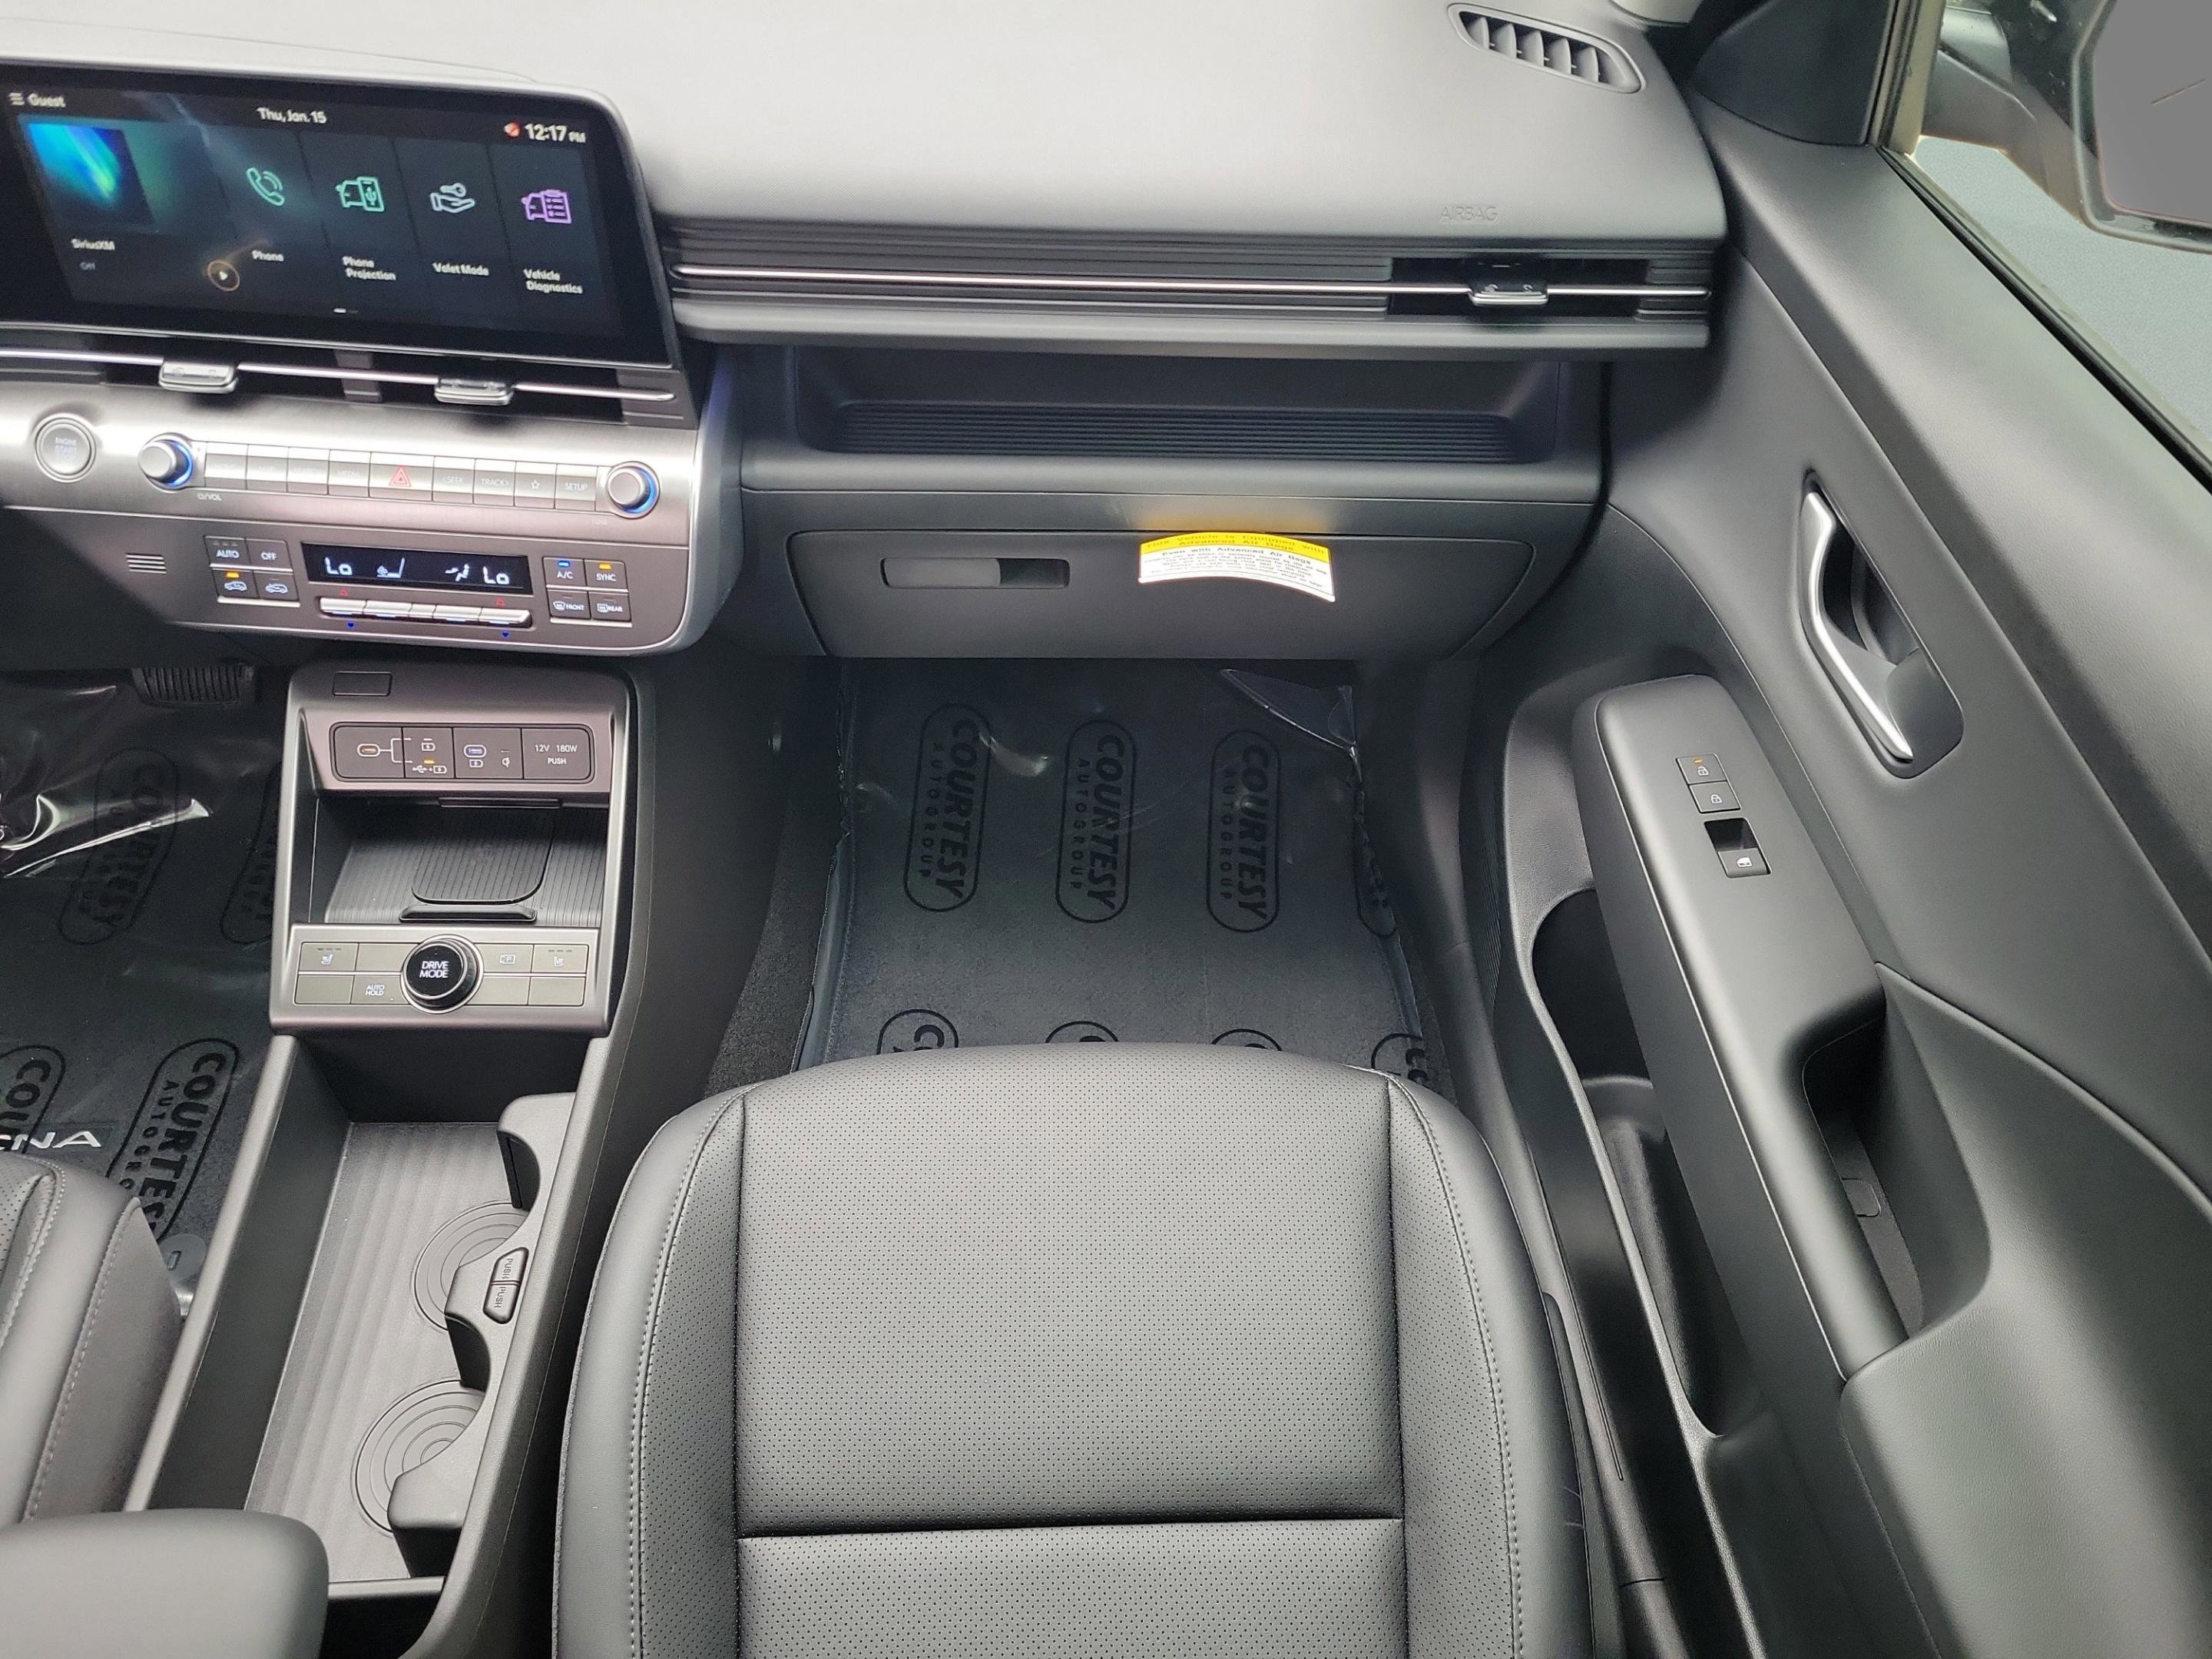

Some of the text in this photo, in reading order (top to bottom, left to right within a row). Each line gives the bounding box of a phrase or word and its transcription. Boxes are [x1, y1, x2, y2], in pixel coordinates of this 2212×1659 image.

[28, 93, 66, 108] Guest
[310, 111, 327, 124] 15
[525, 123, 586, 144] 12:17 PM
[1439, 206, 1499, 222] AIRBAG
[251, 250, 284, 262] Phone
[343, 256, 375, 269] Phone
[346, 267, 396, 282] Projection
[432, 261, 489, 276] Valet Mode
[523, 268, 561, 282] Vehicle
[526, 280, 583, 295] Diagnostics
[565, 482, 589, 492] SETUP
[216, 549, 240, 559] AUTO
[260, 551, 277, 561] OFF
[557, 571, 574, 579] A/C
[596, 573, 617, 581] SYNC
[535, 743, 578, 753] 12V 180W
[547, 757, 567, 766] PUSH
[935, 718, 979, 899] COURTESY
[1087, 734, 1125, 910] COURTESY
[1238, 744, 1270, 920] COURTESY
[421, 960, 449, 969] DRIVE
[419, 969, 449, 979] MODE
[502, 1257, 514, 1280] PUSH
[494, 1286, 506, 1308] PUSH
